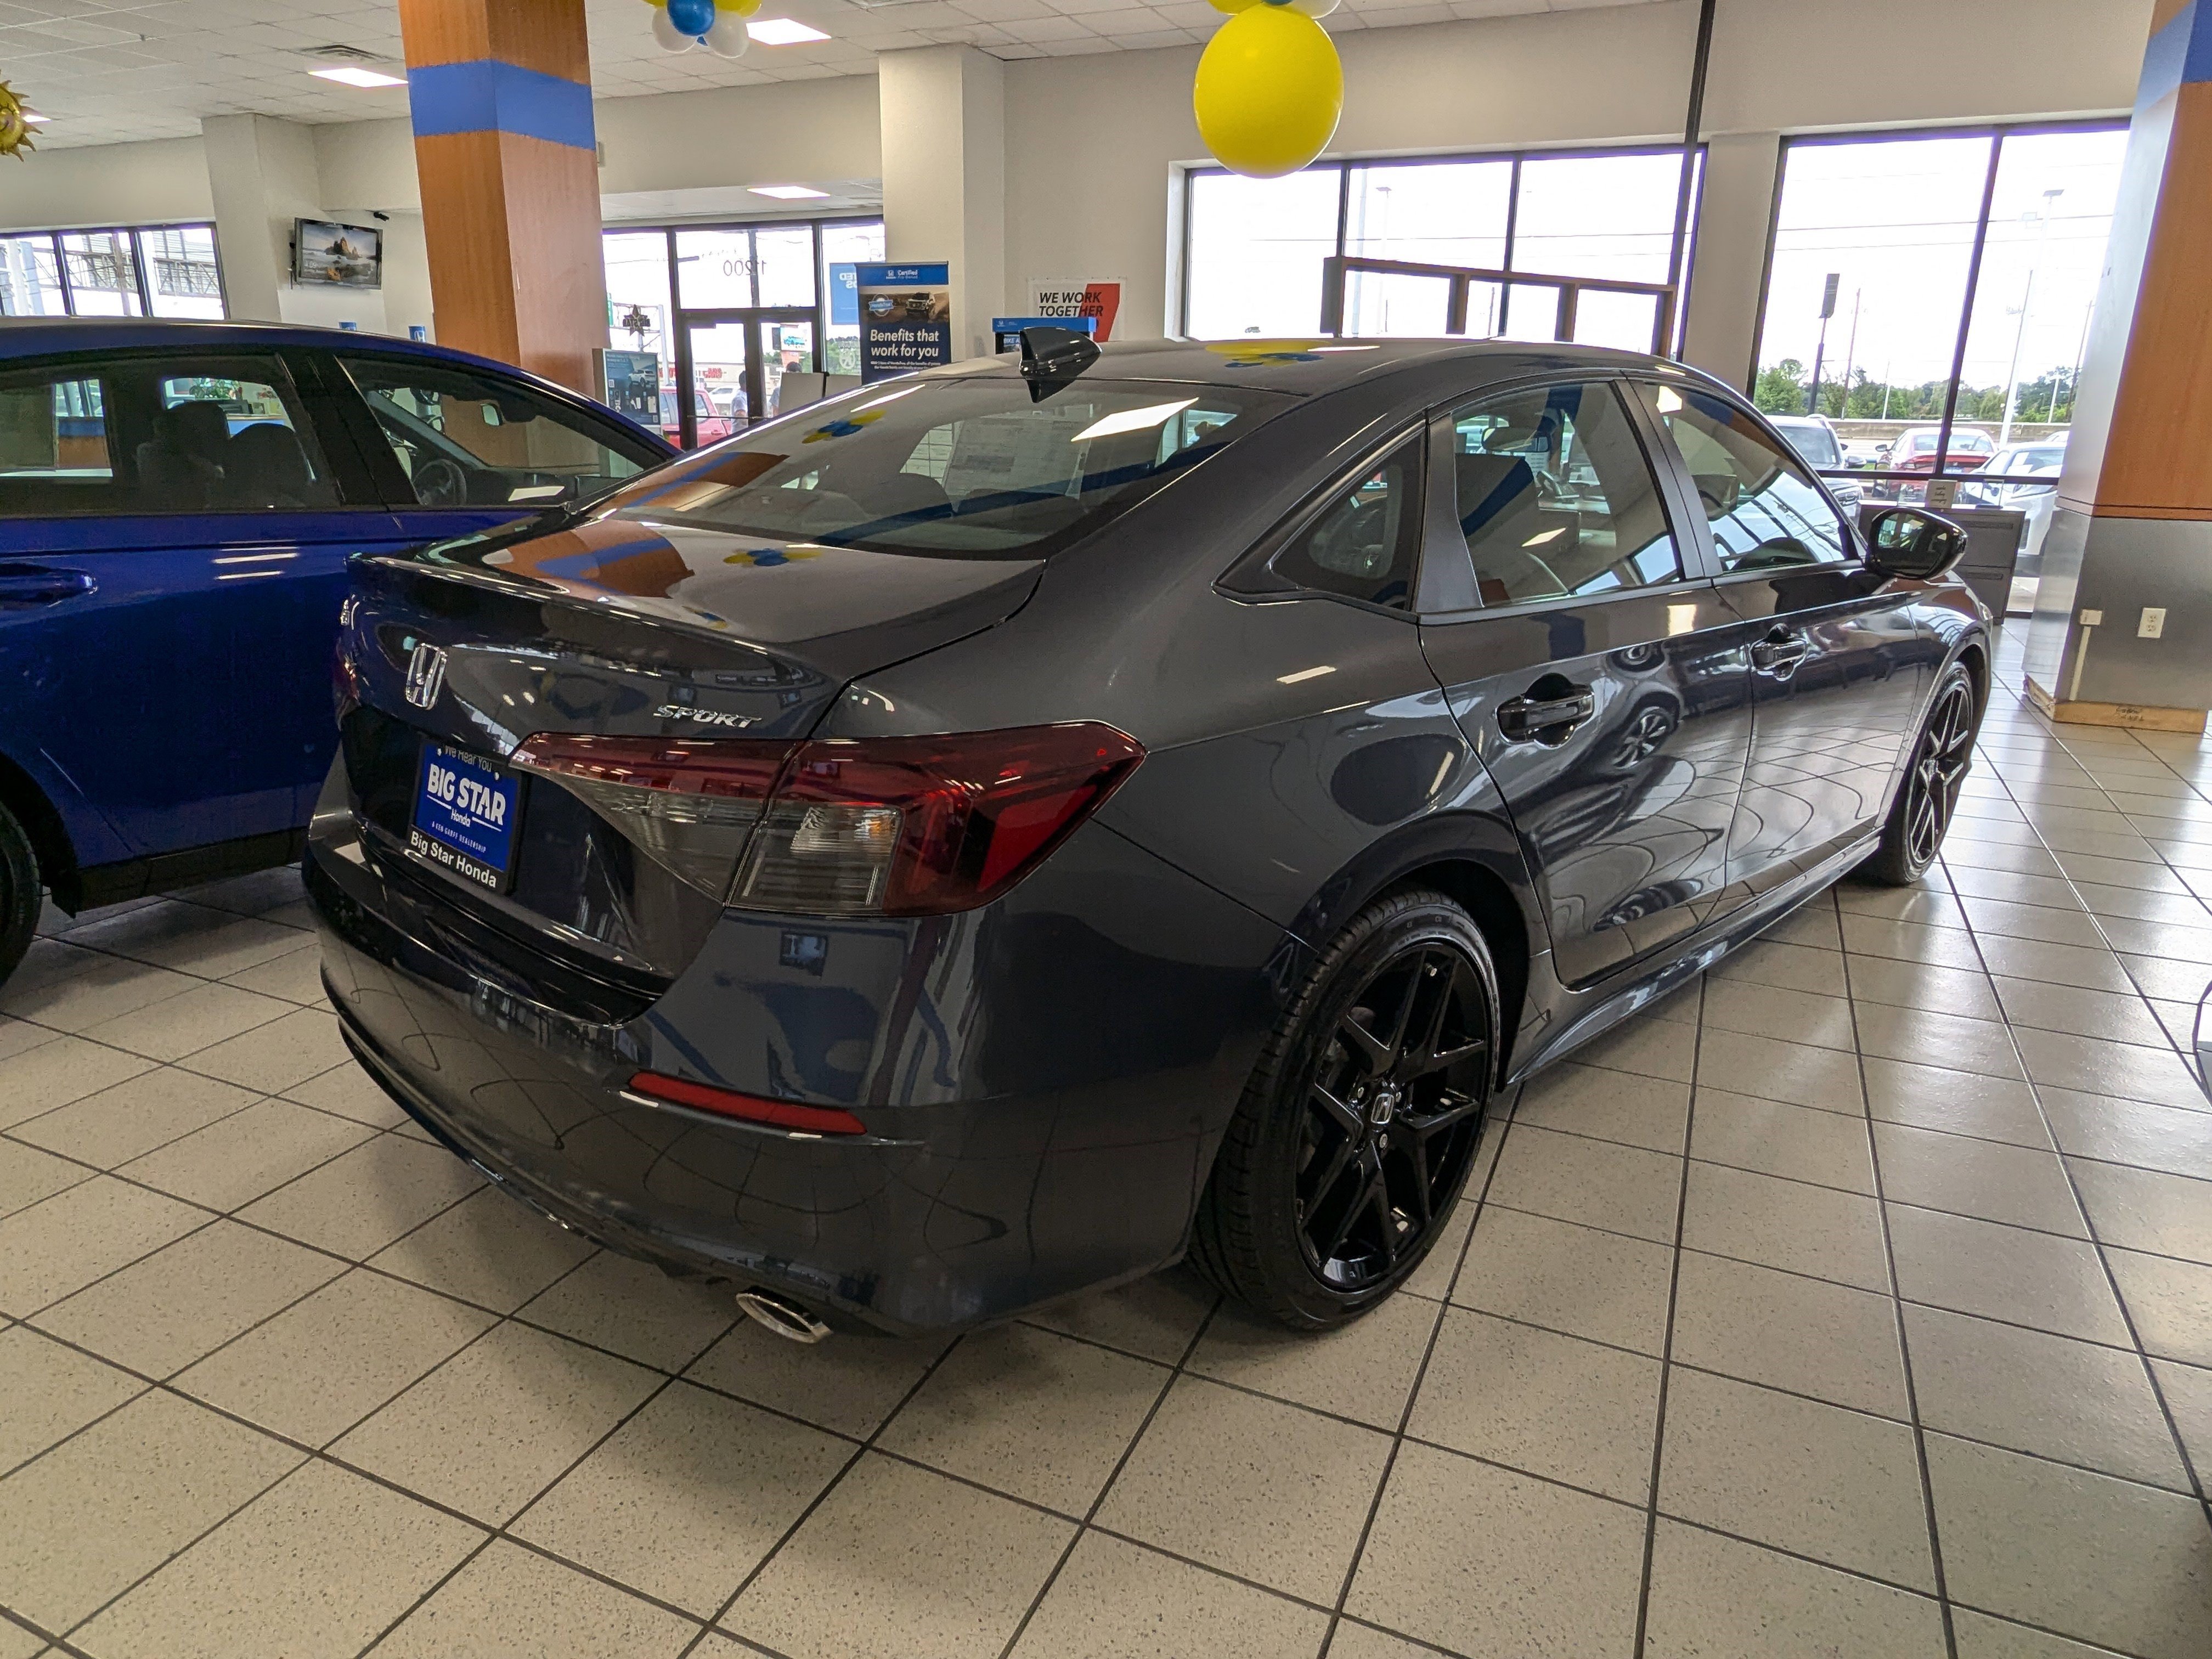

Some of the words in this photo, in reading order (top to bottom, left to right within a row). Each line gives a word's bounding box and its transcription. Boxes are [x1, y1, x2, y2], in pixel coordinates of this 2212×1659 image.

[1039, 292, 1059, 303] WE
[1062, 291, 1102, 303] WORK
[1039, 305, 1104, 317] TOGETHER
[870, 328, 915, 342] Benefits
[917, 328, 940, 342] that
[871, 343, 898, 357] work
[900, 343, 916, 357] for
[918, 346, 939, 360] you
[653, 704, 763, 729] SPORT
[427, 763, 456, 801] BIG
[456, 777, 506, 826] STAR
[450, 808, 471, 828] Honda
[411, 831, 428, 857] Big
[430, 842, 454, 866] Star
[456, 856, 498, 888] Honda
